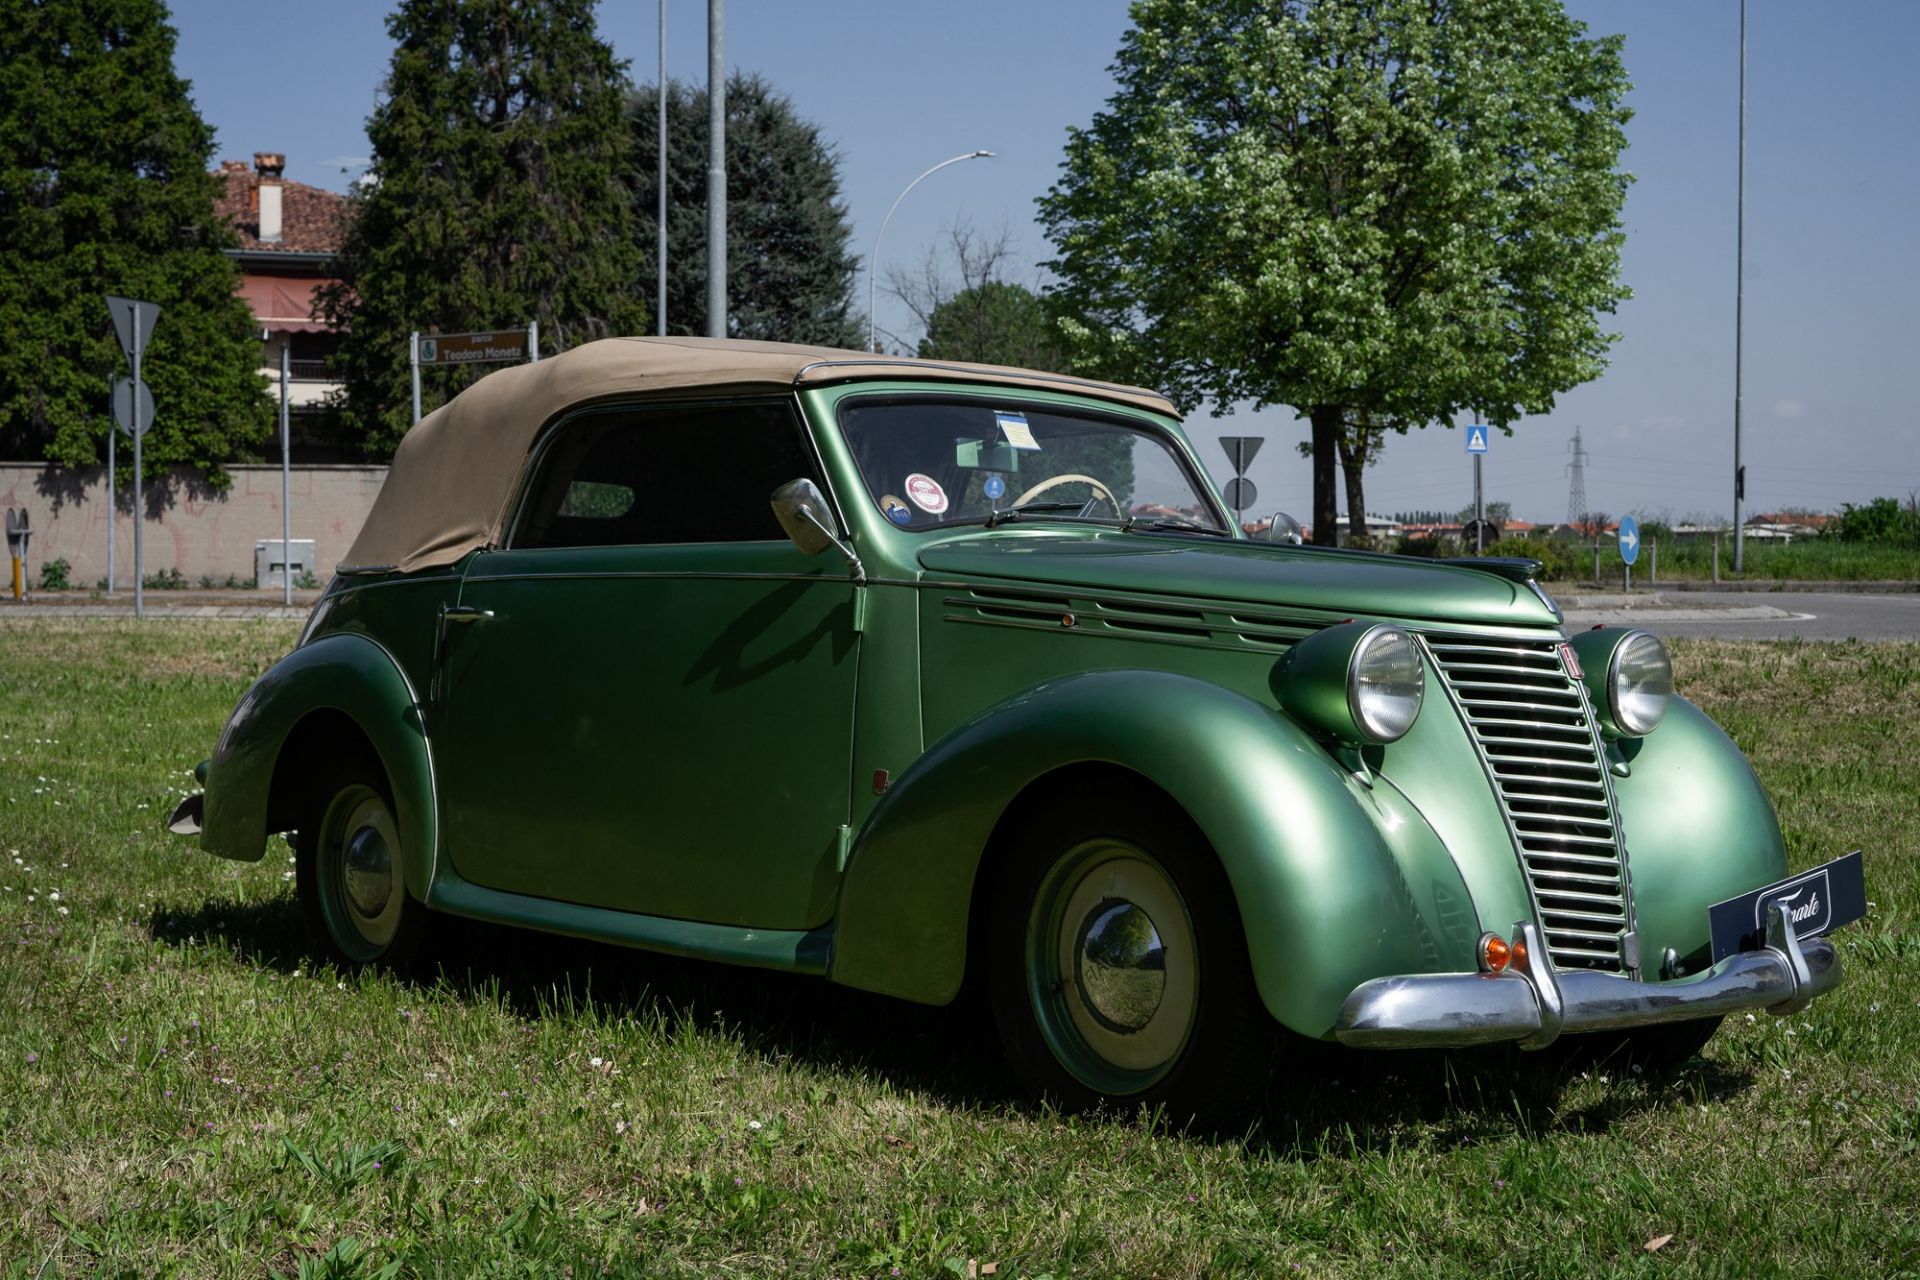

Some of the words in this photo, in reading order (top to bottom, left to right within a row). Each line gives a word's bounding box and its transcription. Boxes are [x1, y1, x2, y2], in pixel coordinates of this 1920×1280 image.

[471, 335, 493, 344] parco
[444, 348, 483, 361] Teodoro
[485, 346, 521, 358] Moneta
